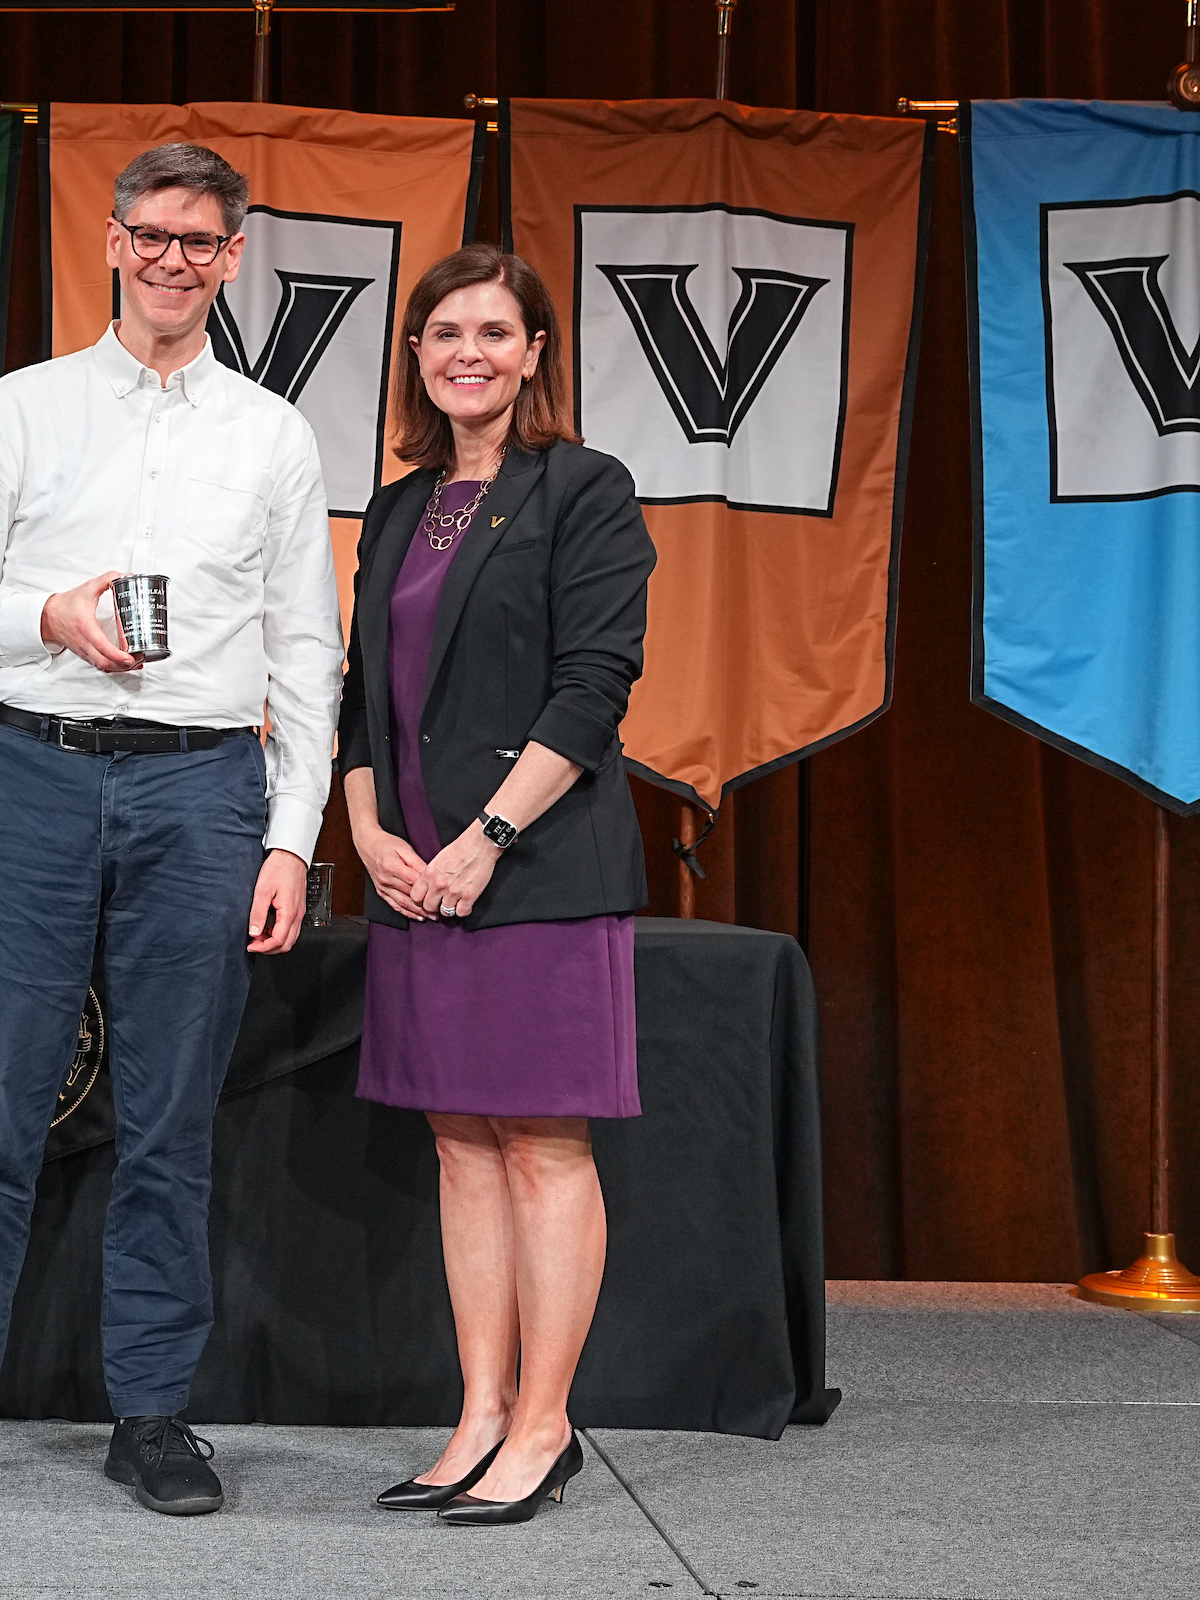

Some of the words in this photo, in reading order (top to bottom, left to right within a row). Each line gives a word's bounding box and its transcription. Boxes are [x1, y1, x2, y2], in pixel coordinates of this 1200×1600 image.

[205, 268, 376, 406] V
[595, 263, 830, 449] V
[1062, 254, 1200, 437] V
[490, 515, 506, 528] V
